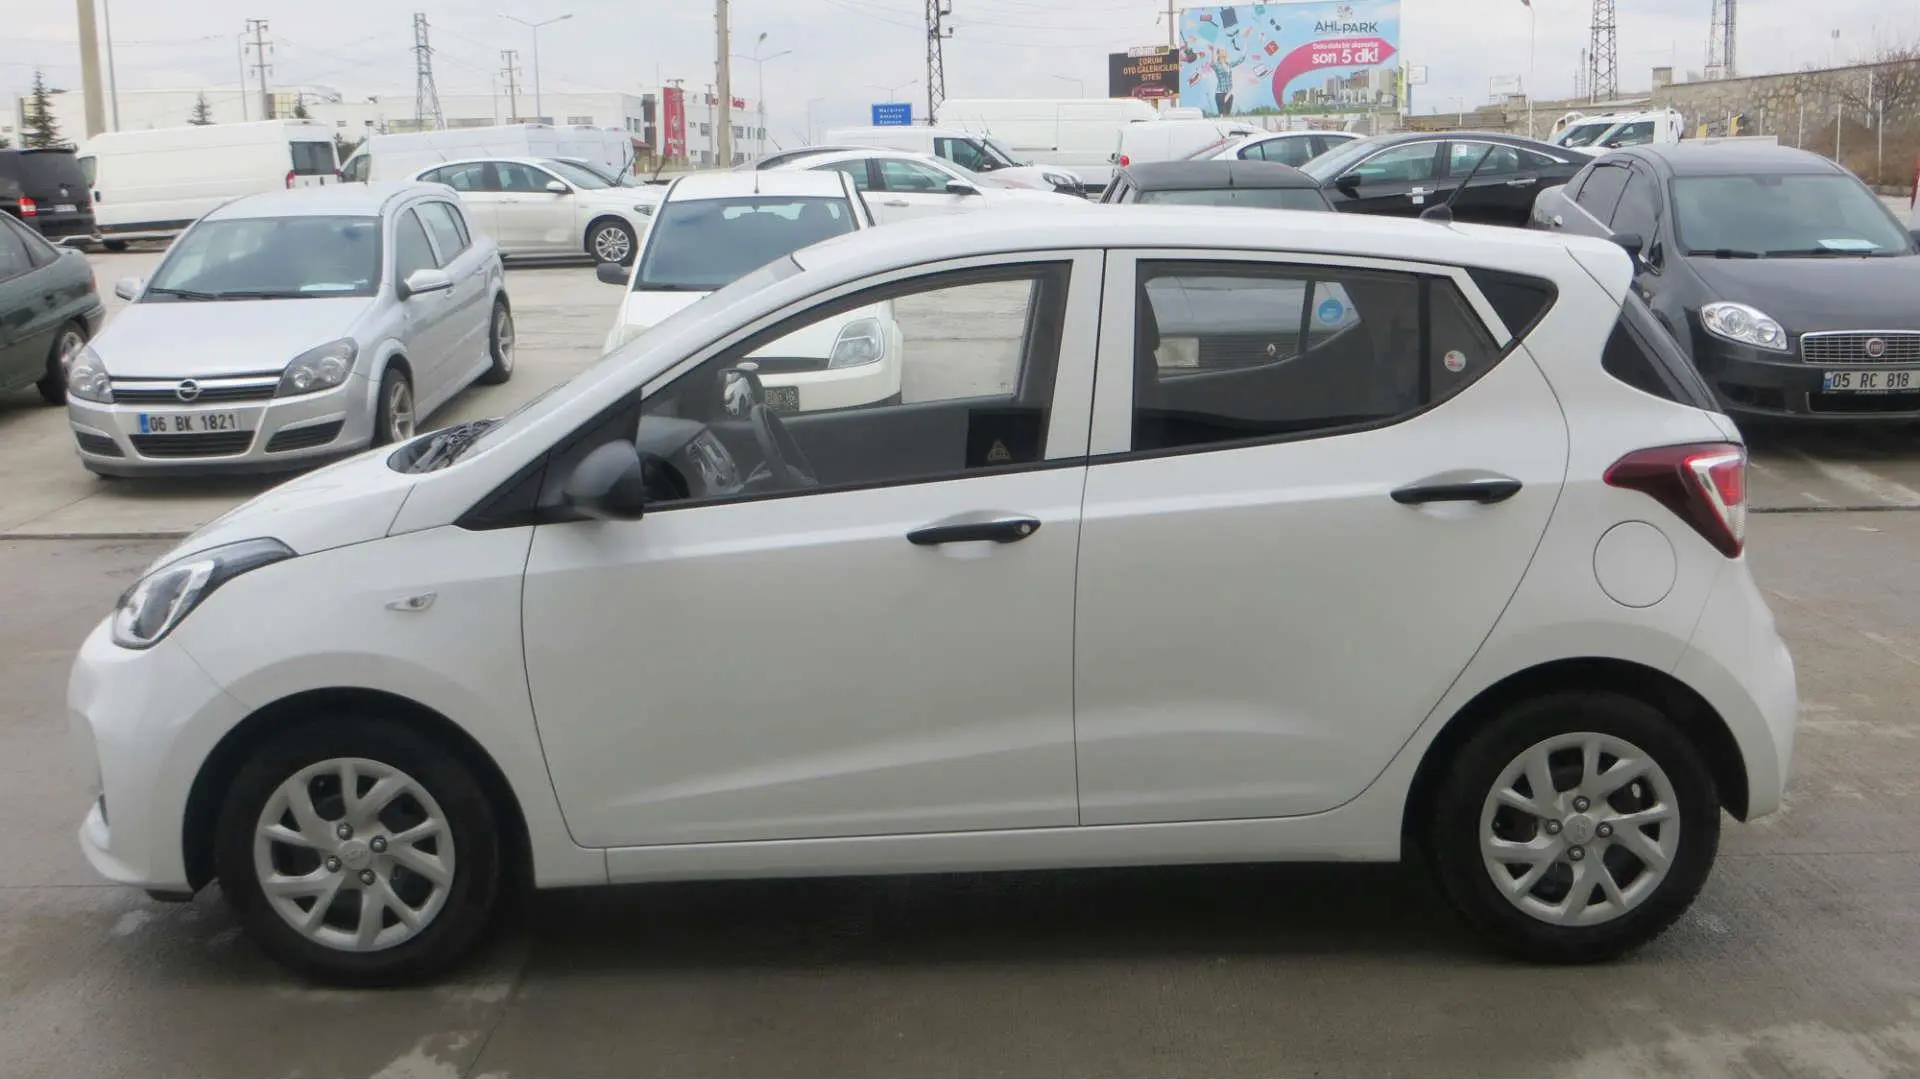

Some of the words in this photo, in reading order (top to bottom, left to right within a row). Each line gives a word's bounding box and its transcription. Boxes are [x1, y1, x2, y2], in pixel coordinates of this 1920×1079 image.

[1312, 52, 1337, 64] son
[1342, 49, 1352, 64] 5
[1833, 372, 1851, 388] 05
[1860, 372, 1878, 388] RC
[1887, 372, 1910, 388] 818
[150, 416, 167, 432] 06
[175, 415, 193, 431] BK
[201, 414, 236, 431] 1821
